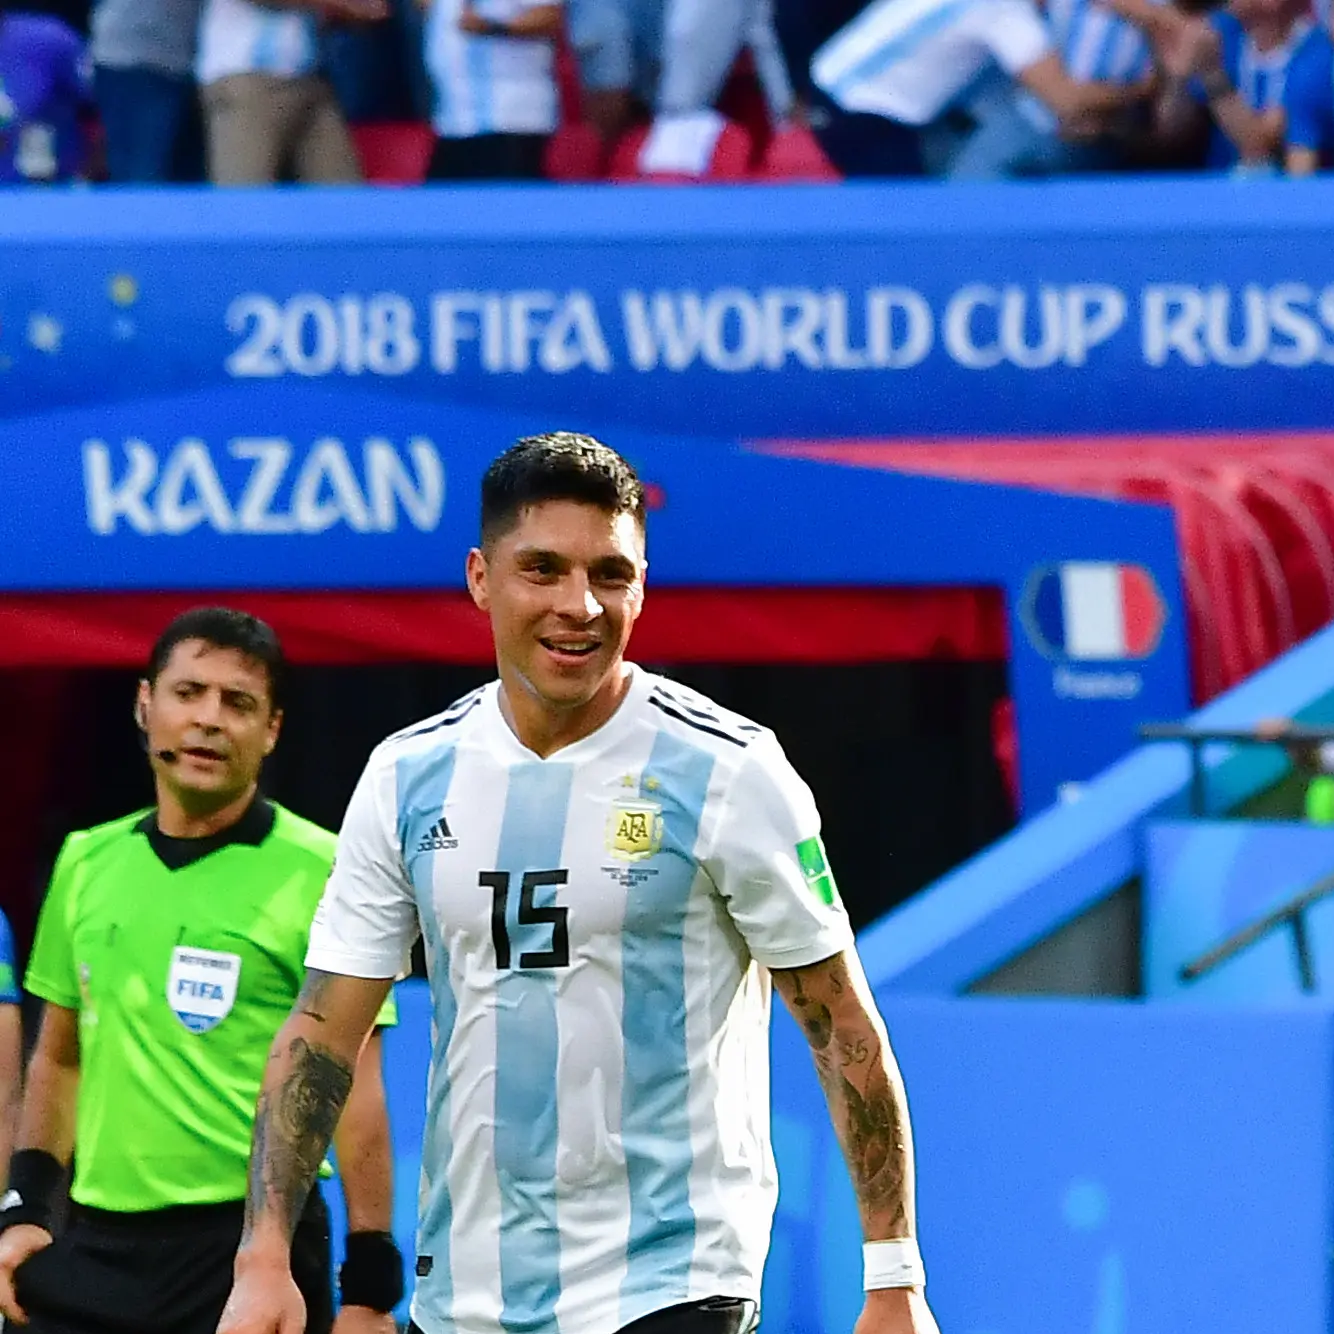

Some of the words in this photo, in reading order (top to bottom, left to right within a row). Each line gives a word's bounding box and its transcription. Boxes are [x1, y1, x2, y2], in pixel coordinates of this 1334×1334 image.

[225, 293, 421, 377] 2018
[431, 290, 611, 374] FIFA
[621, 288, 933, 372] WORLD
[943, 284, 1127, 370] CUP
[82, 436, 446, 536] KAZAN
[478, 868, 570, 970] 15
[177, 978, 224, 1001] FIFA
